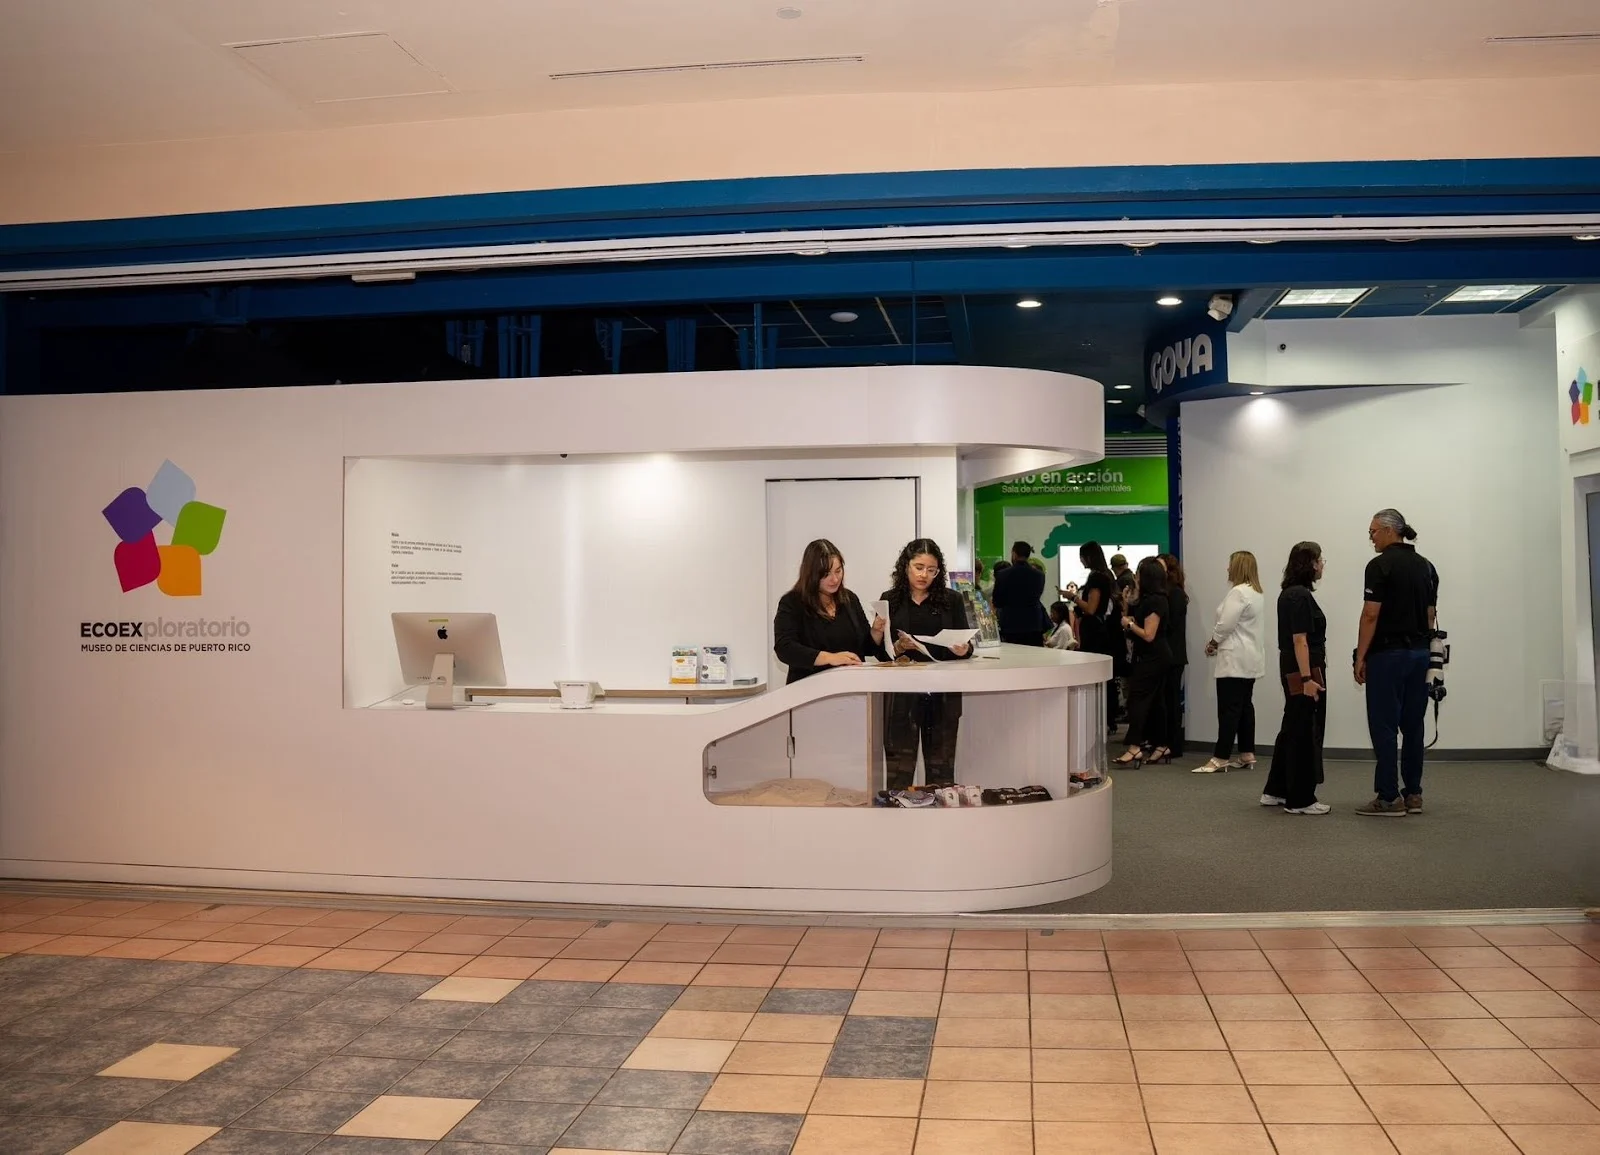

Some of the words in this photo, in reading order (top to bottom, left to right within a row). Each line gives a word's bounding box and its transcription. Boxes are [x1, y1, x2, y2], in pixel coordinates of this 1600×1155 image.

[1150, 333, 1213, 394] GOYA
[1040, 472, 1062, 484] en
[1066, 468, 1124, 484] acción
[1001, 485, 1019, 493] Sala
[1020, 485, 1032, 493] de
[1032, 485, 1083, 495] embajadores
[1084, 484, 1132, 493] ambientales
[80, 616, 251, 642] ECOEXploratorio
[81, 644, 113, 652] MUSEO
[115, 644, 127, 652] DE
[129, 644, 172, 652] CIENCIAS
[174, 644, 187, 652] DE
[189, 643, 226, 652] PUERTO
[228, 643, 251, 652] RICO
